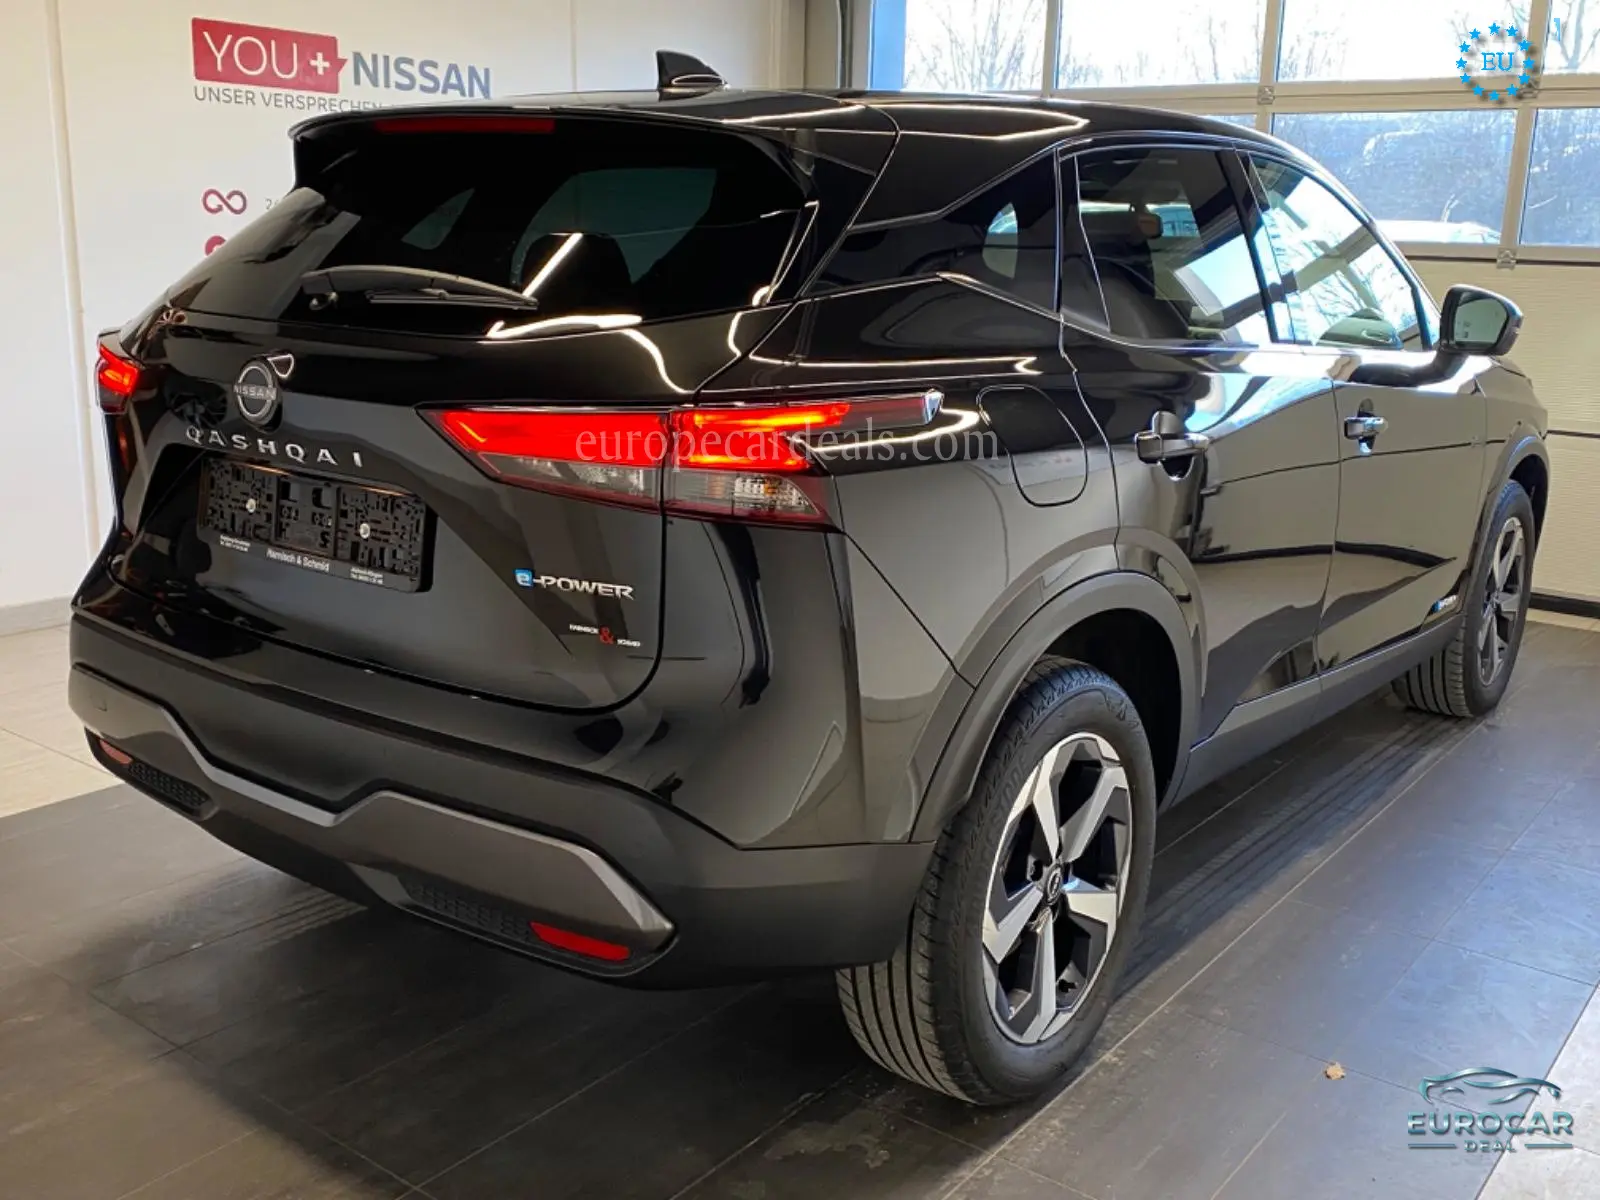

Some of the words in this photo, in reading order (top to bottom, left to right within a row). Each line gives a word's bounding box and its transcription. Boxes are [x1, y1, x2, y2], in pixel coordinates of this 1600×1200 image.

[352, 51, 491, 99] NISSAN
[194, 86, 256, 105] UNSER
[234, 384, 277, 400] NISSAN
[186, 425, 363, 467] QASHQAI
